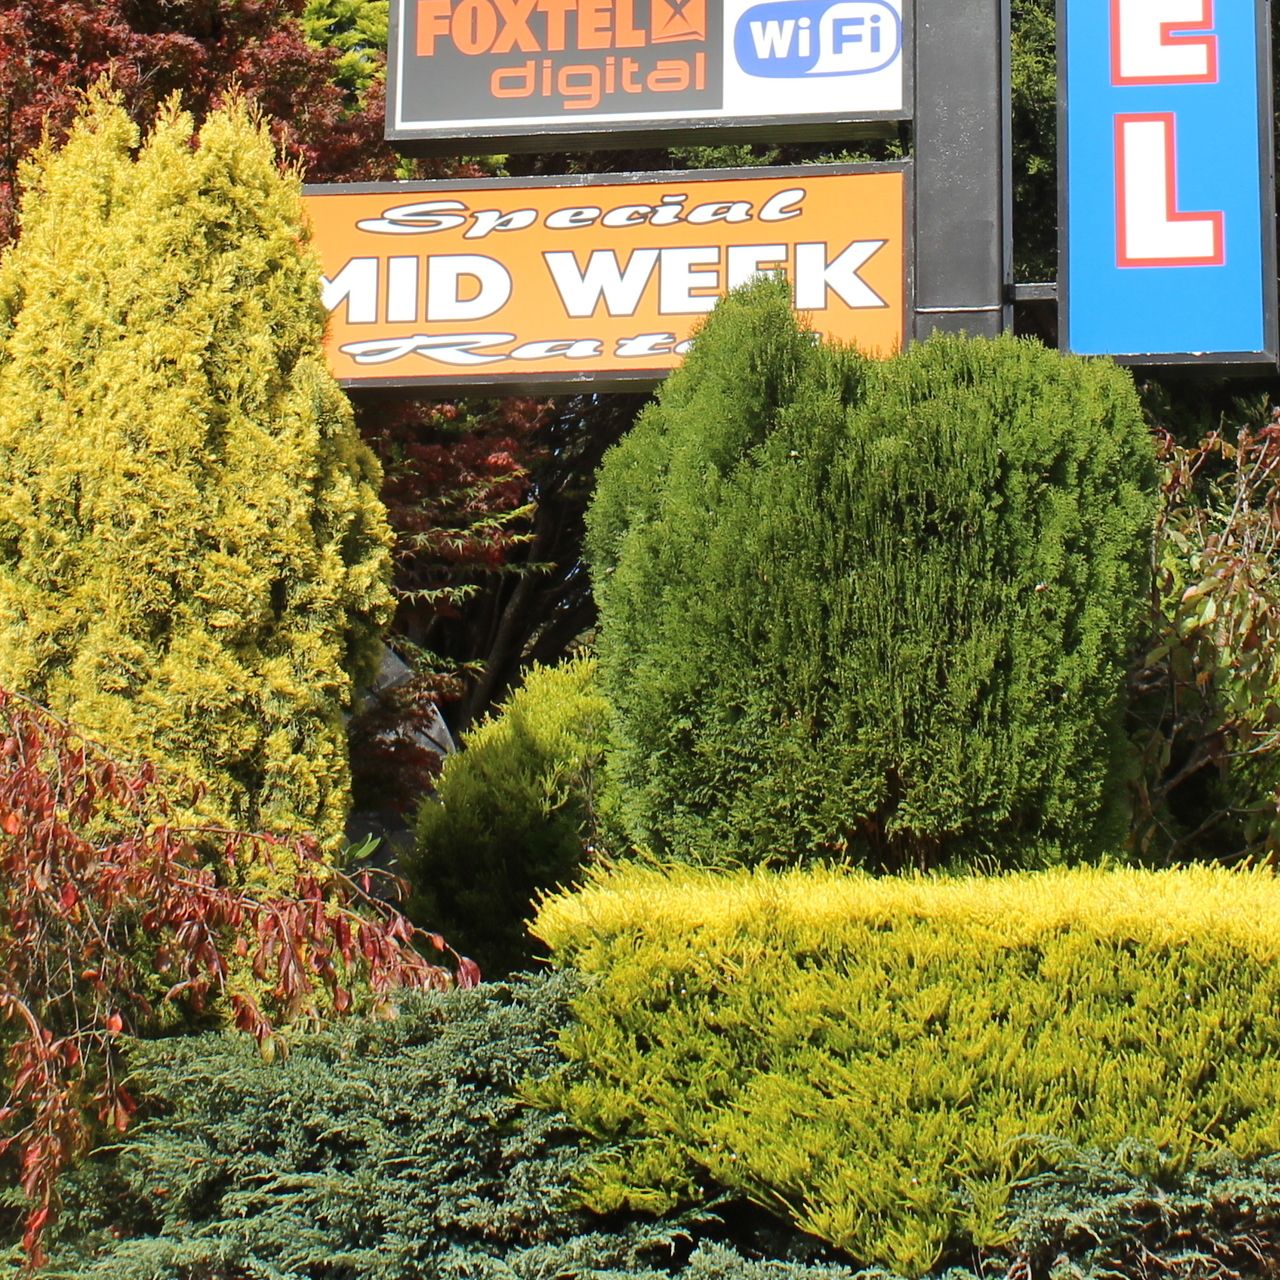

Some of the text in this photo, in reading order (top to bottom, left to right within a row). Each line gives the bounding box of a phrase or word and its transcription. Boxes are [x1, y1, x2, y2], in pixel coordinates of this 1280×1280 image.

[490, 52, 706, 111] digital
[355, 187, 807, 240] Special
[320, 254, 514, 325] MID
